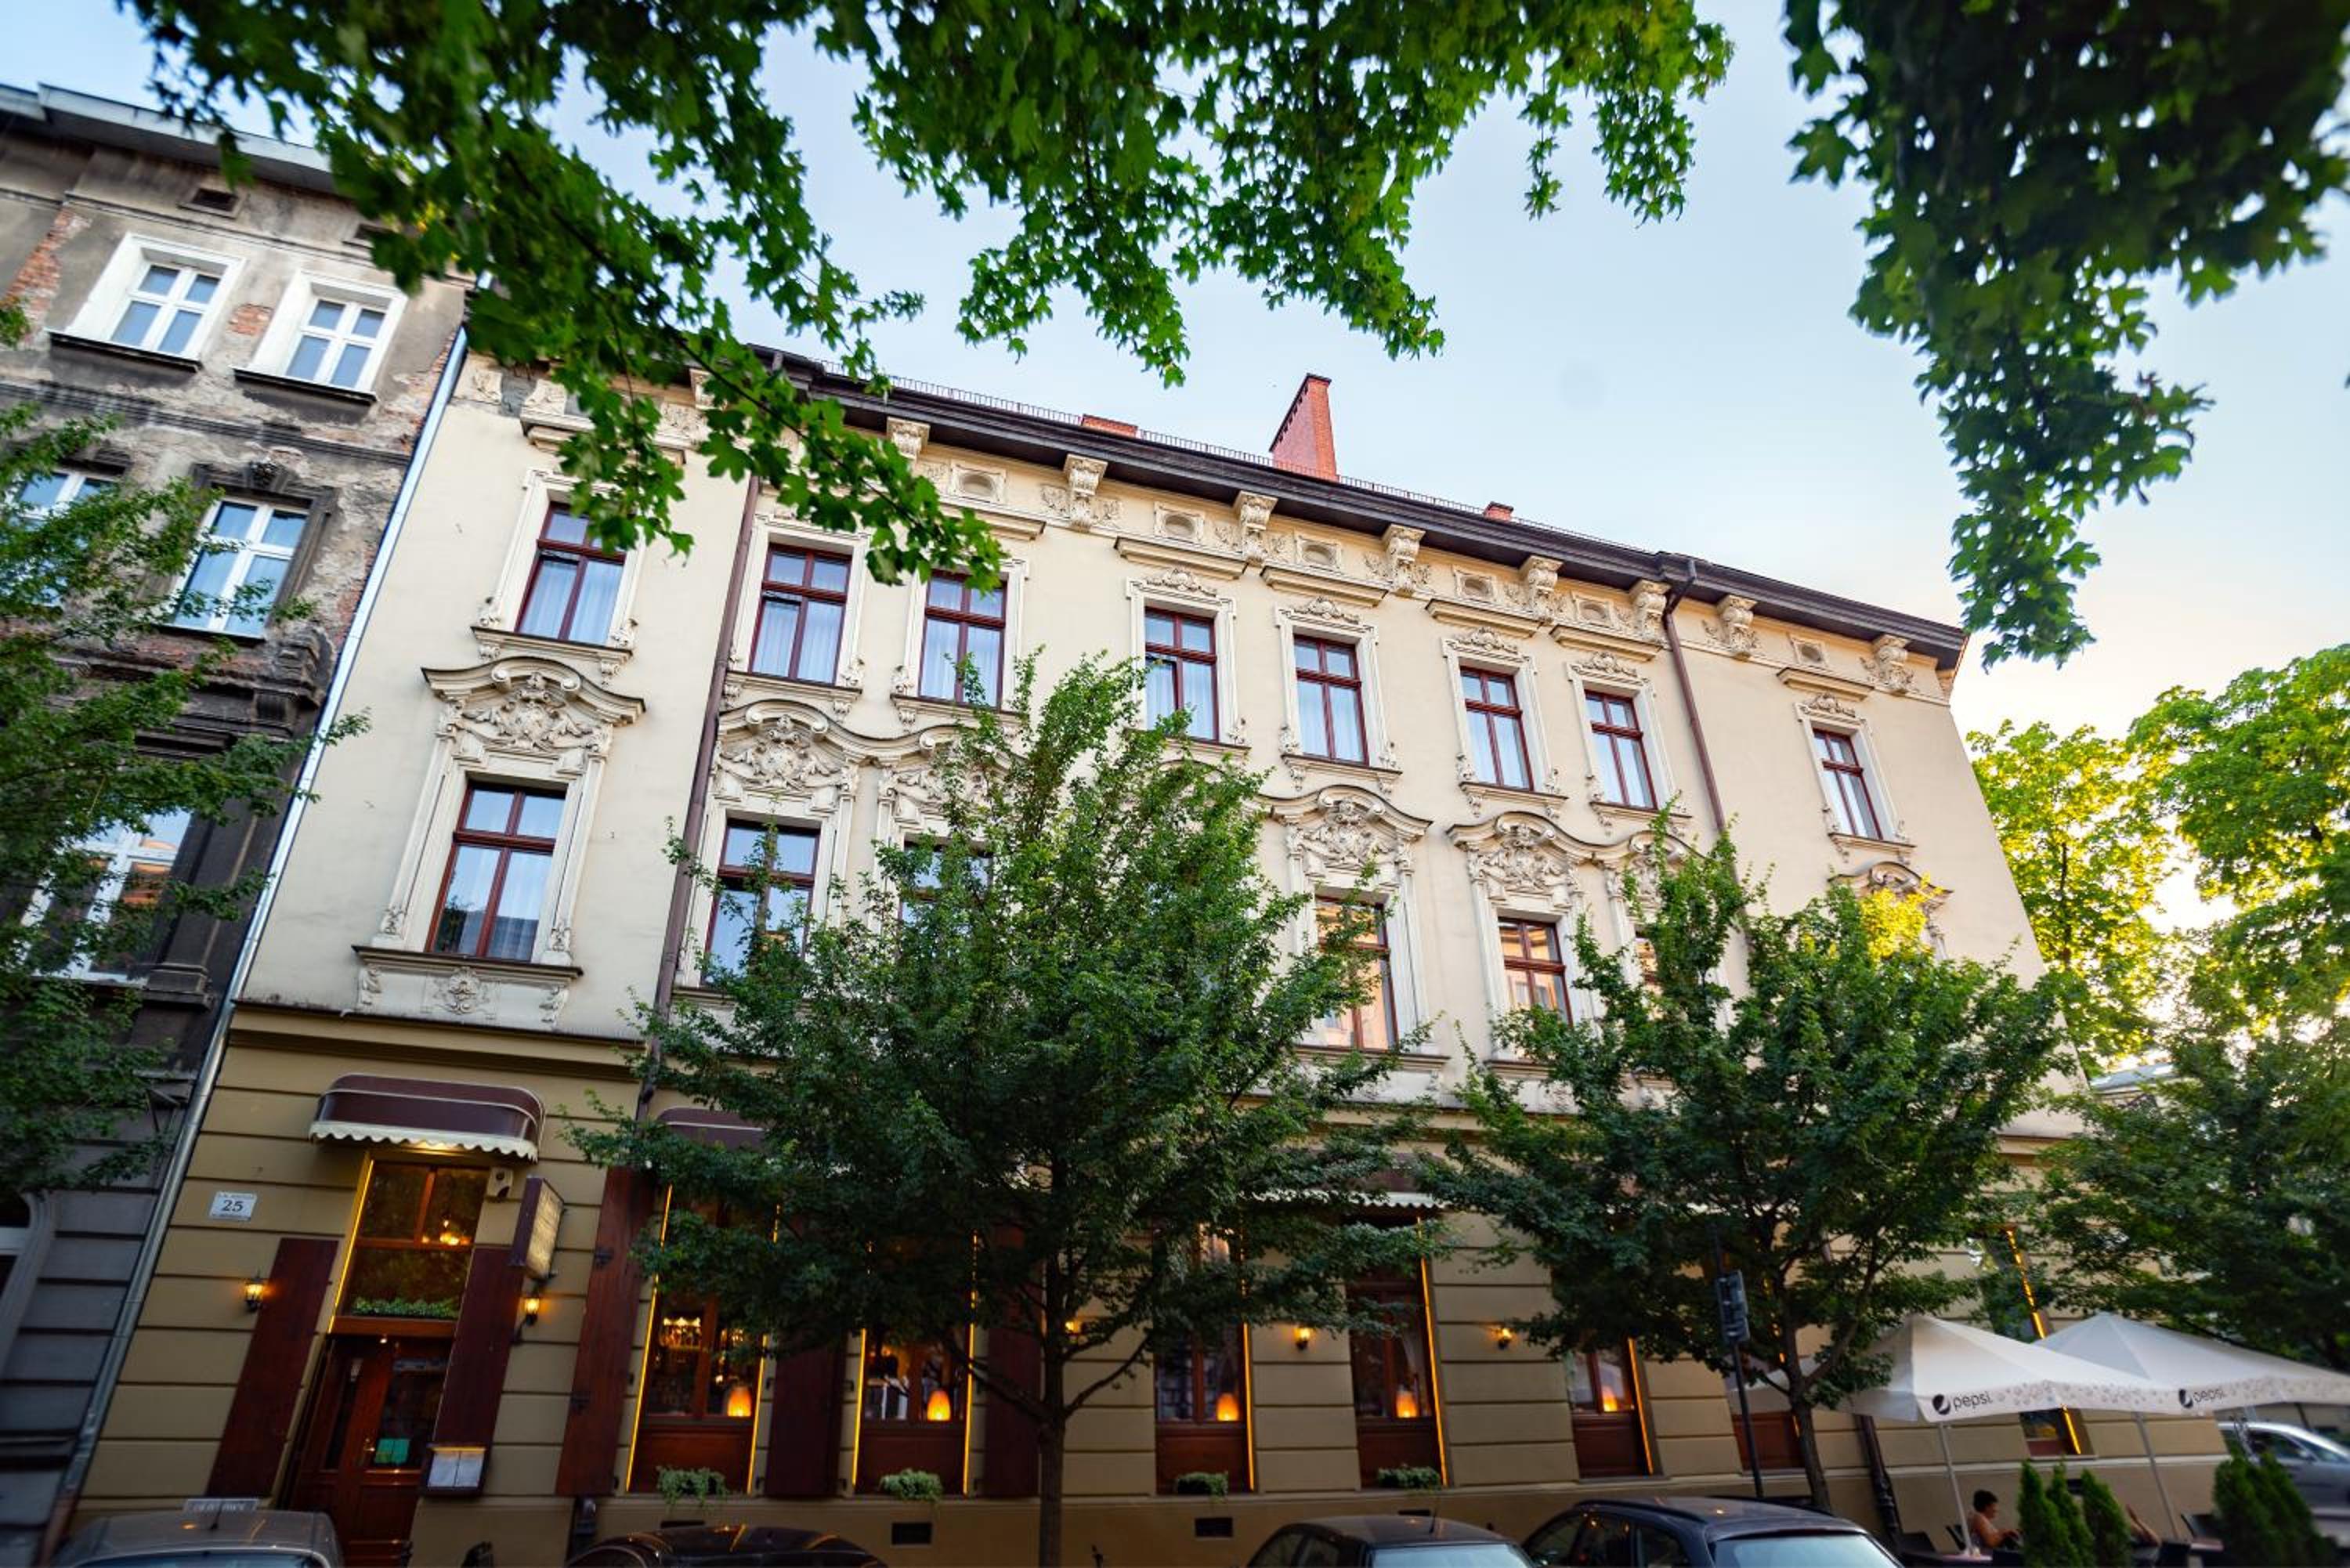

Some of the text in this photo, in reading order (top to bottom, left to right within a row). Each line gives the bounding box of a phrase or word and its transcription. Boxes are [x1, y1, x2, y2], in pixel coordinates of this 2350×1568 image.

[221, 1199, 244, 1212] 25
[1953, 1391, 1993, 1411] pepsi
[2193, 1386, 2227, 1406] pepsi
